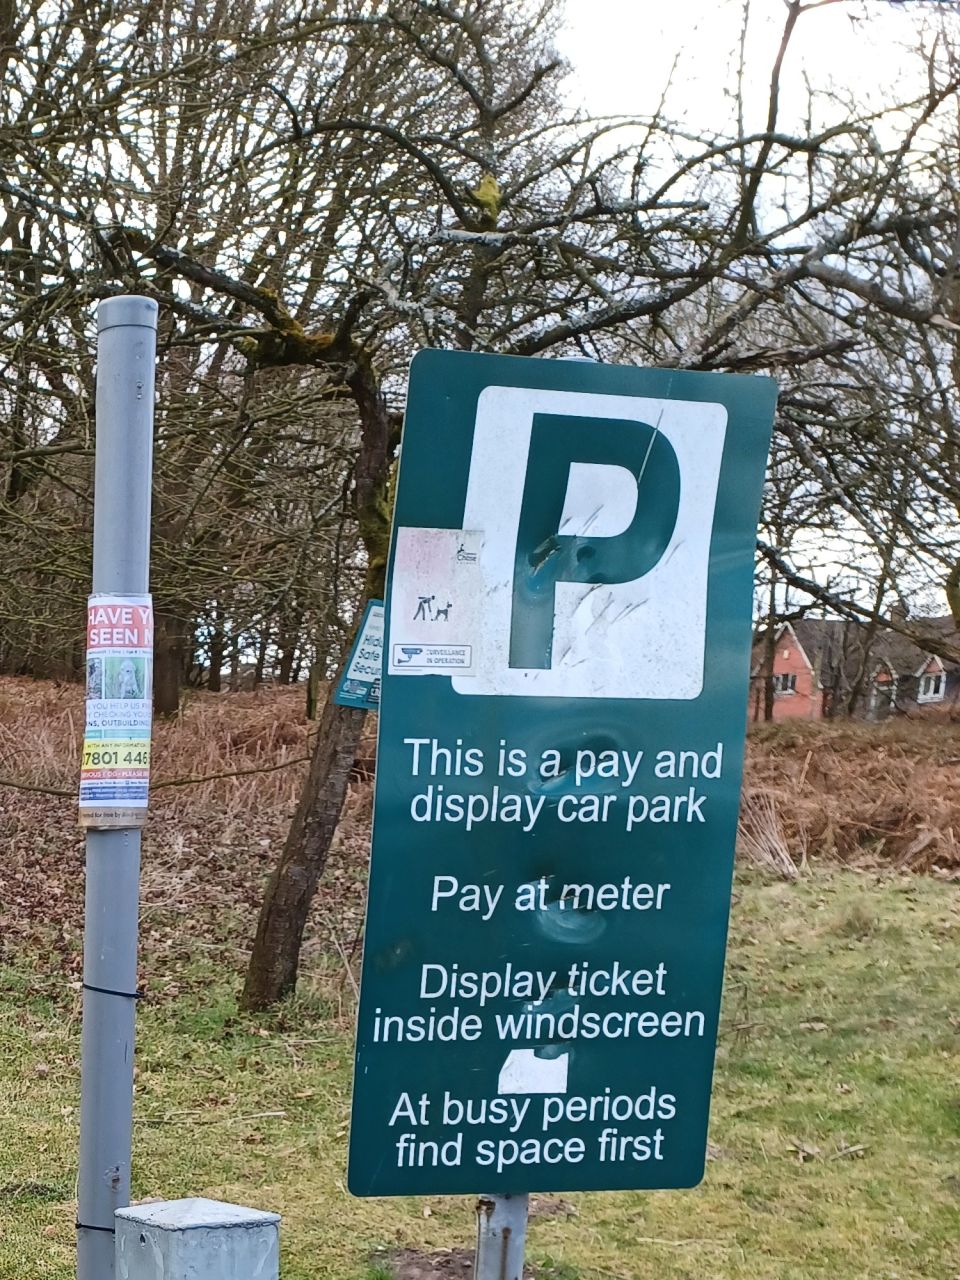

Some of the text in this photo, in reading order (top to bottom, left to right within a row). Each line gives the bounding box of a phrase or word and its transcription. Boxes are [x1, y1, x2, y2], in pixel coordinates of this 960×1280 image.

[509, 413, 681, 670] P
[88, 608, 152, 625] HAVE Y
[90, 628, 138, 645] SEEN
[353, 661, 382, 675] Secur
[93, 702, 108, 710] YOU
[404, 738, 723, 788] This is a pay and
[410, 786, 706, 831] display car park
[431, 876, 670, 920] Pay at meter
[420, 962, 667, 1005] Display ticket
[373, 1005, 705, 1042] inside windscreen
[389, 1087, 676, 1132] At busy periods
[396, 1129, 664, 1173] find space first
